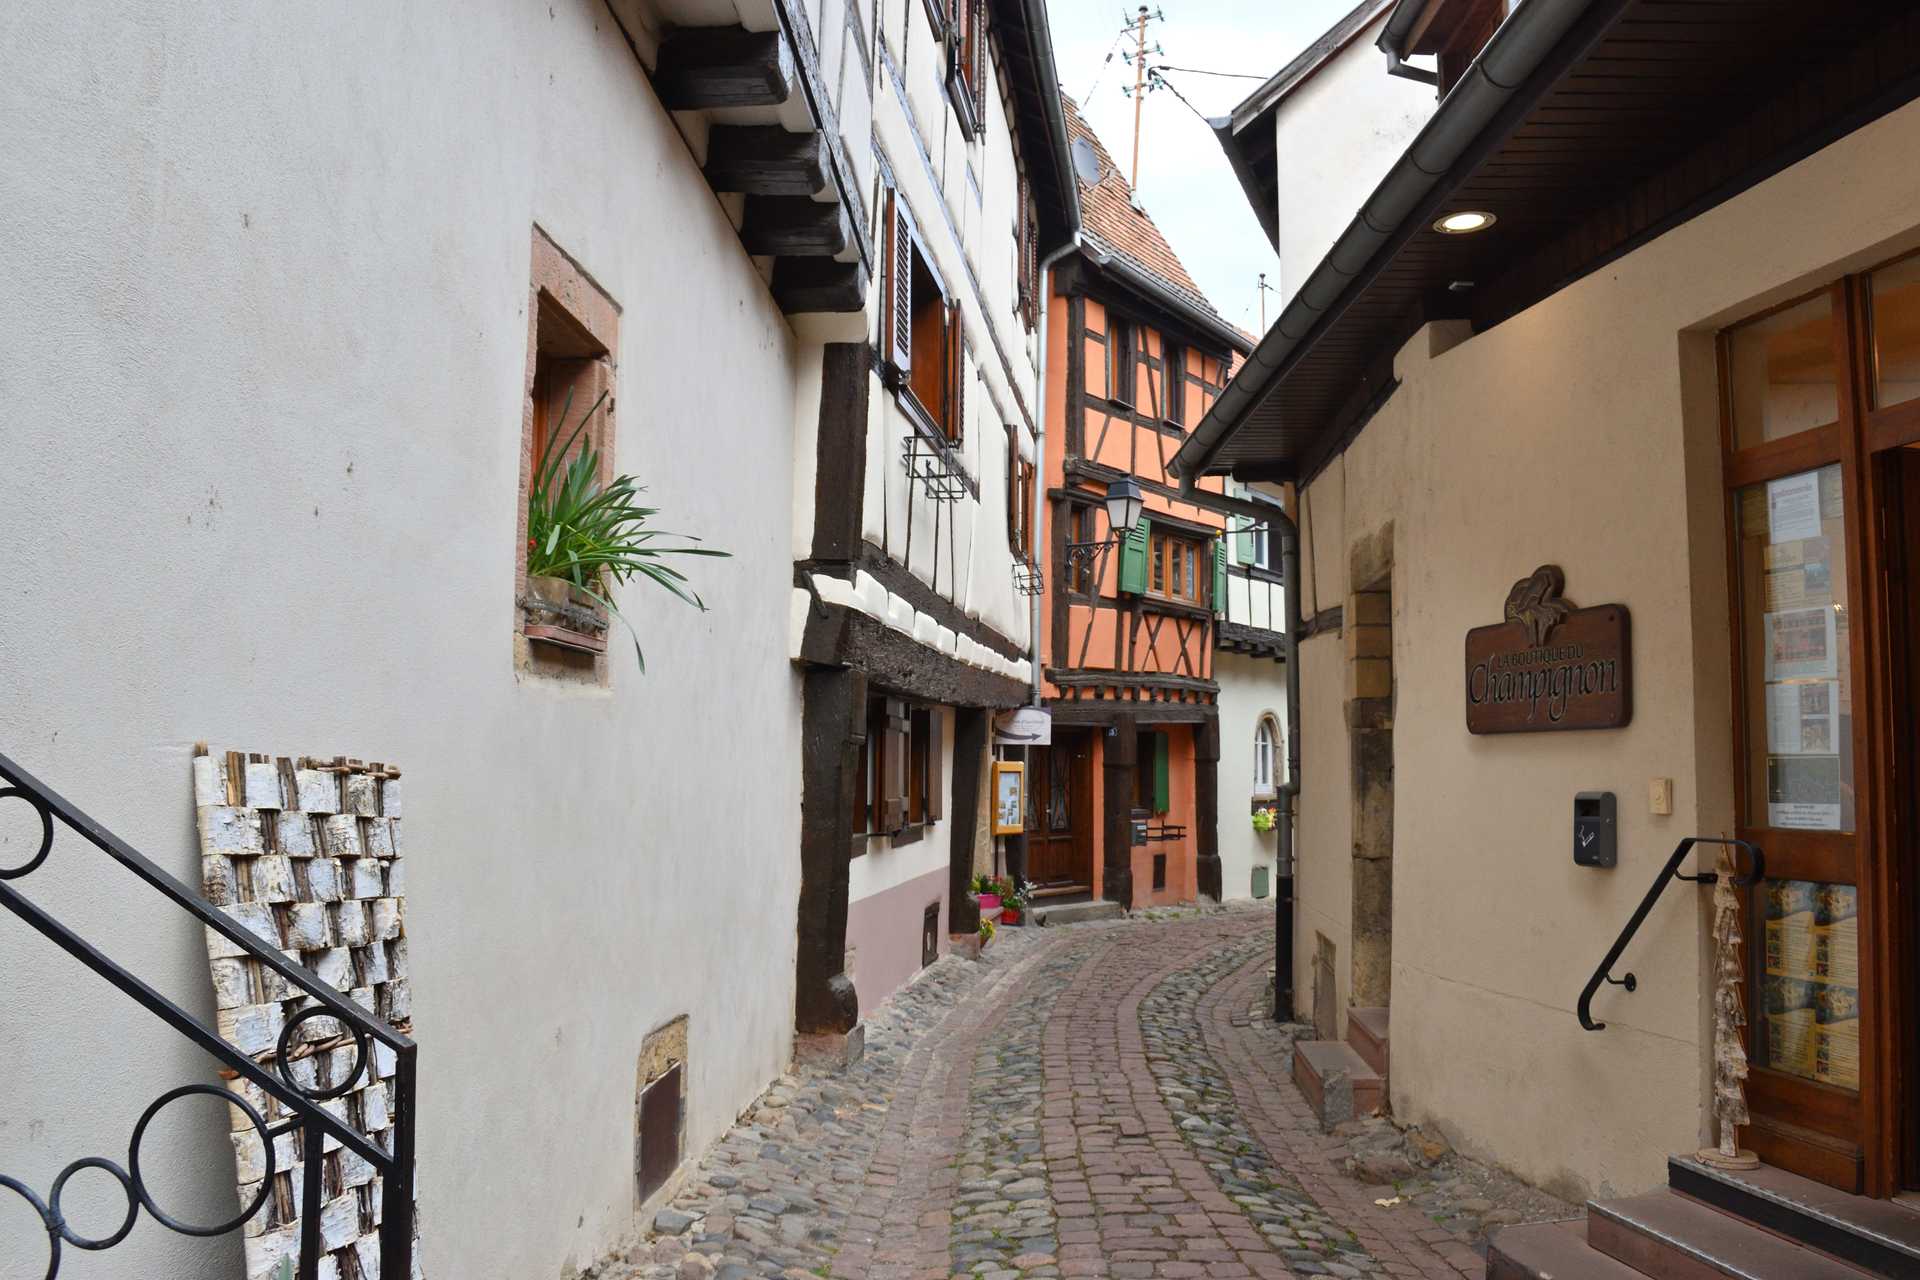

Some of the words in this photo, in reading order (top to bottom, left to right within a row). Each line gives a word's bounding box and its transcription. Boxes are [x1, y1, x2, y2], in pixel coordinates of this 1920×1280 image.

[1498, 655, 1510, 669] LA
[1511, 647, 1566, 666] BOUTIQUE
[1567, 645, 1584, 659] DU
[1469, 653, 1617, 723] Champignon
